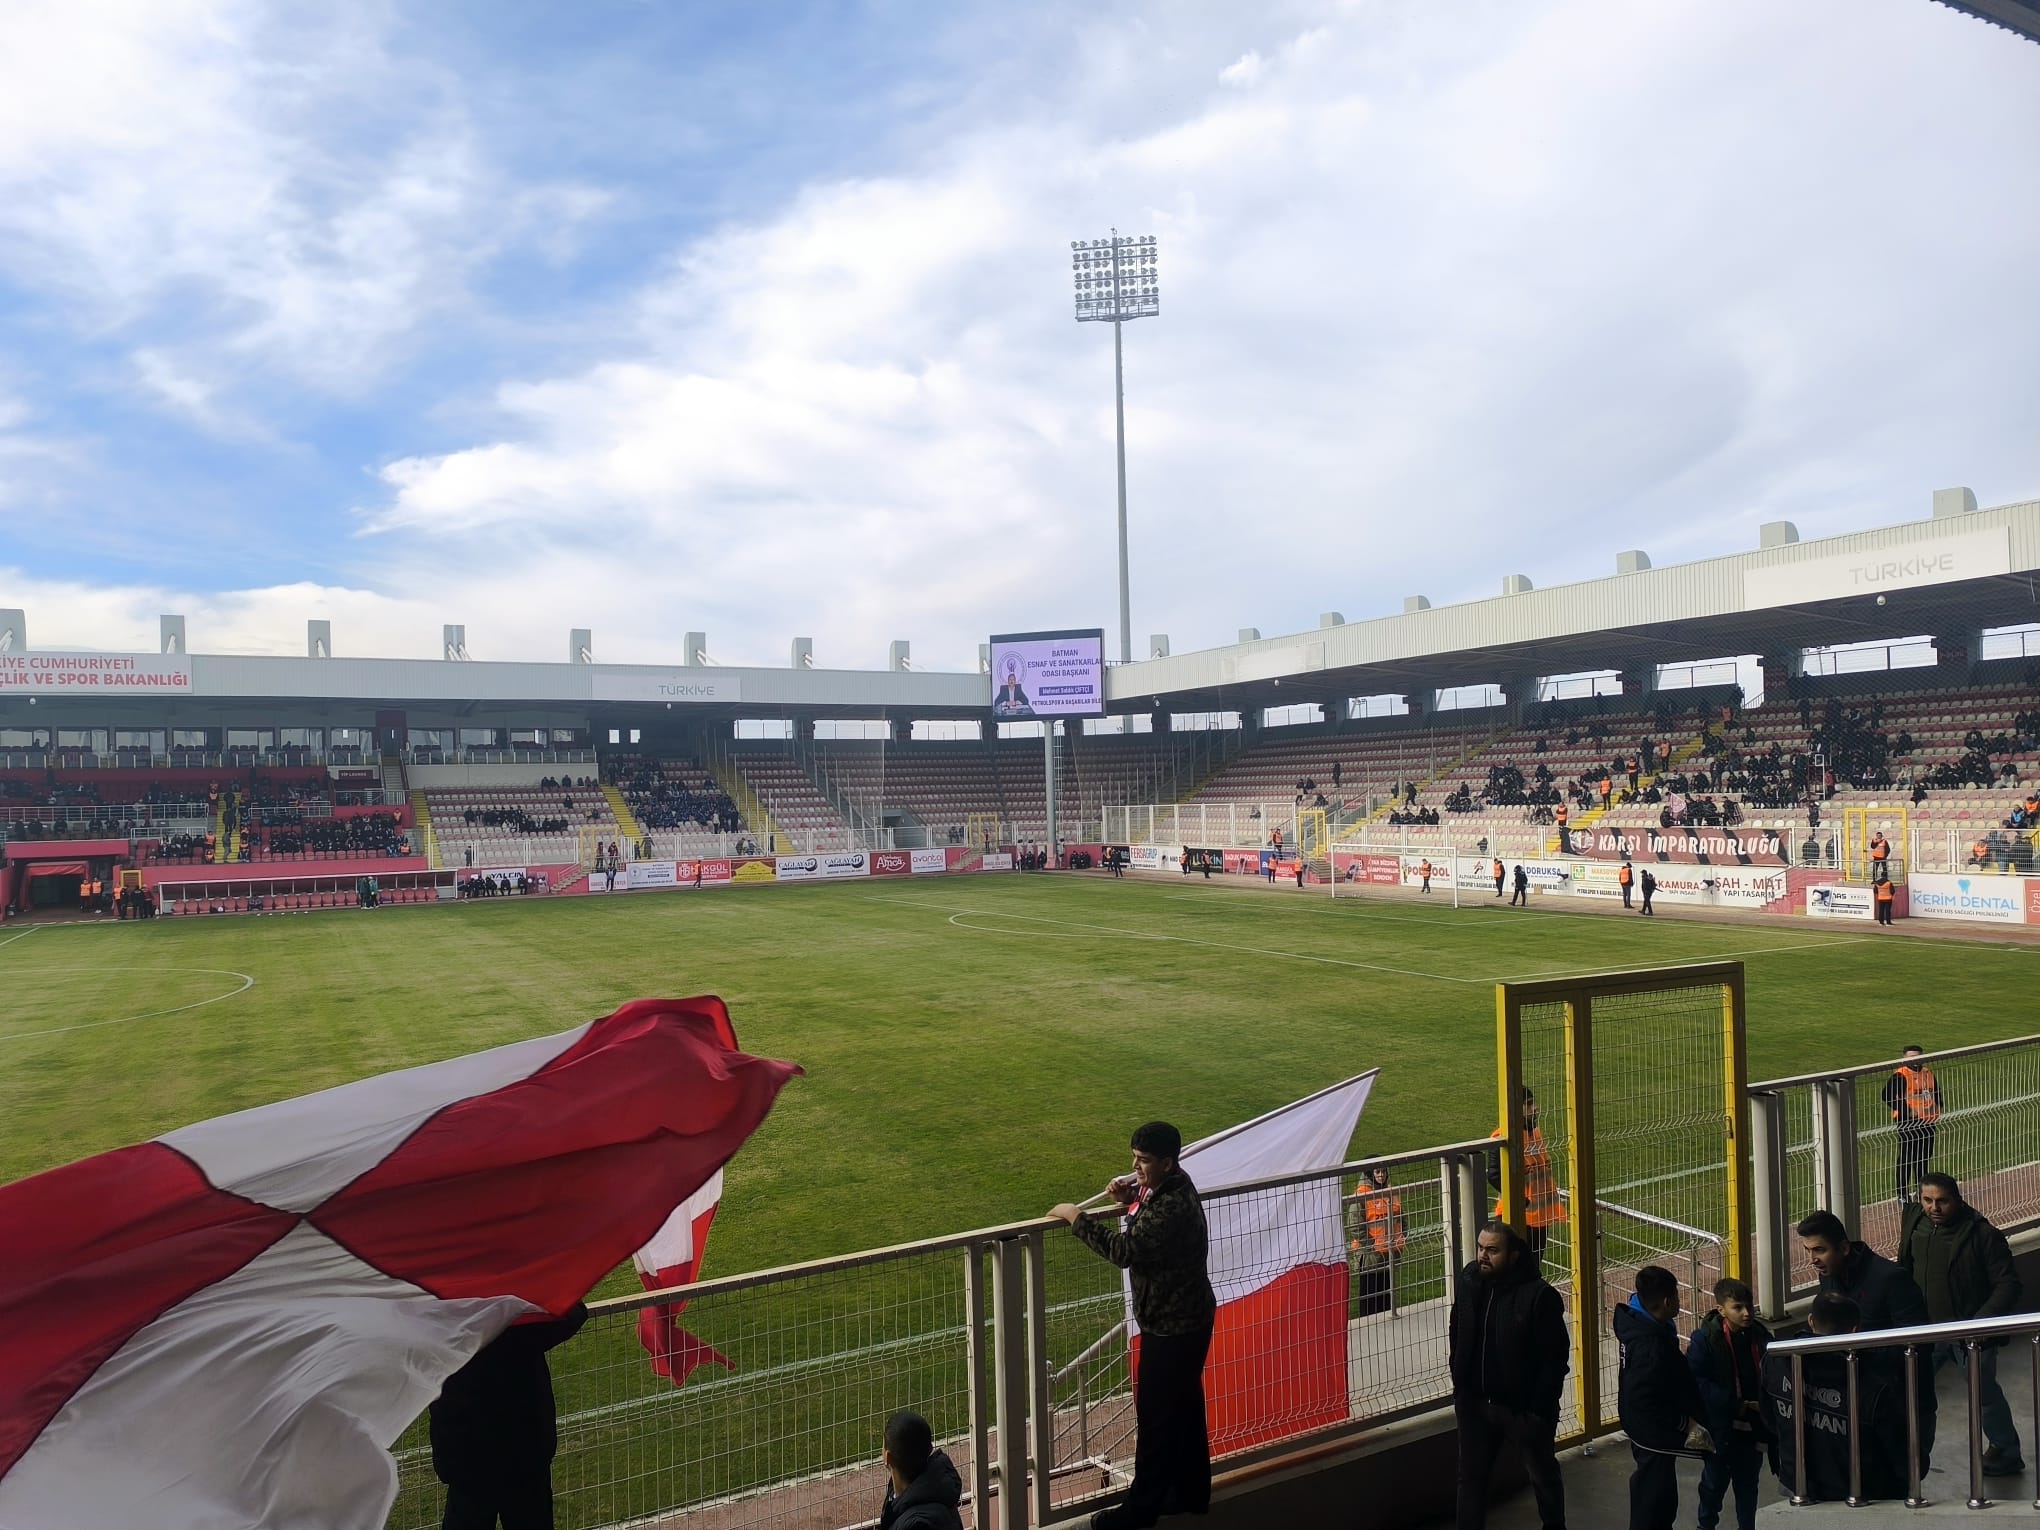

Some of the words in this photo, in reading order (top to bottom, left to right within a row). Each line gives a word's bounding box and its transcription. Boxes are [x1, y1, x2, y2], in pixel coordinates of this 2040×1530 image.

[1848, 553, 1954, 584] TÜRKİYE
[1051, 649, 1079, 658] BATMAN
[30, 655, 135, 670] CUMHURİYETİ
[1027, 660, 1048, 669] ESNAF
[1049, 660, 1057, 668] VE
[34, 672, 54, 685] VE
[58, 673, 99, 686] SPOR
[103, 672, 188, 686] BAKANLIĞI
[1062, 669, 1090, 678] BAŞKANI
[658, 683, 715, 696] TÜRKİYE
[1598, 835, 1641, 855] KARŞI
[1647, 833, 1780, 856] İMPARATORLUĞU
[1658, 880, 1700, 890] KAMURA
[1714, 877, 1740, 891] ŞAH
[1753, 878, 1783, 890] MAT
[1912, 892, 1956, 907] KERİM
[1960, 896, 2019, 911] DENTAL
[1777, 1399, 1847, 1436] BAMAN
